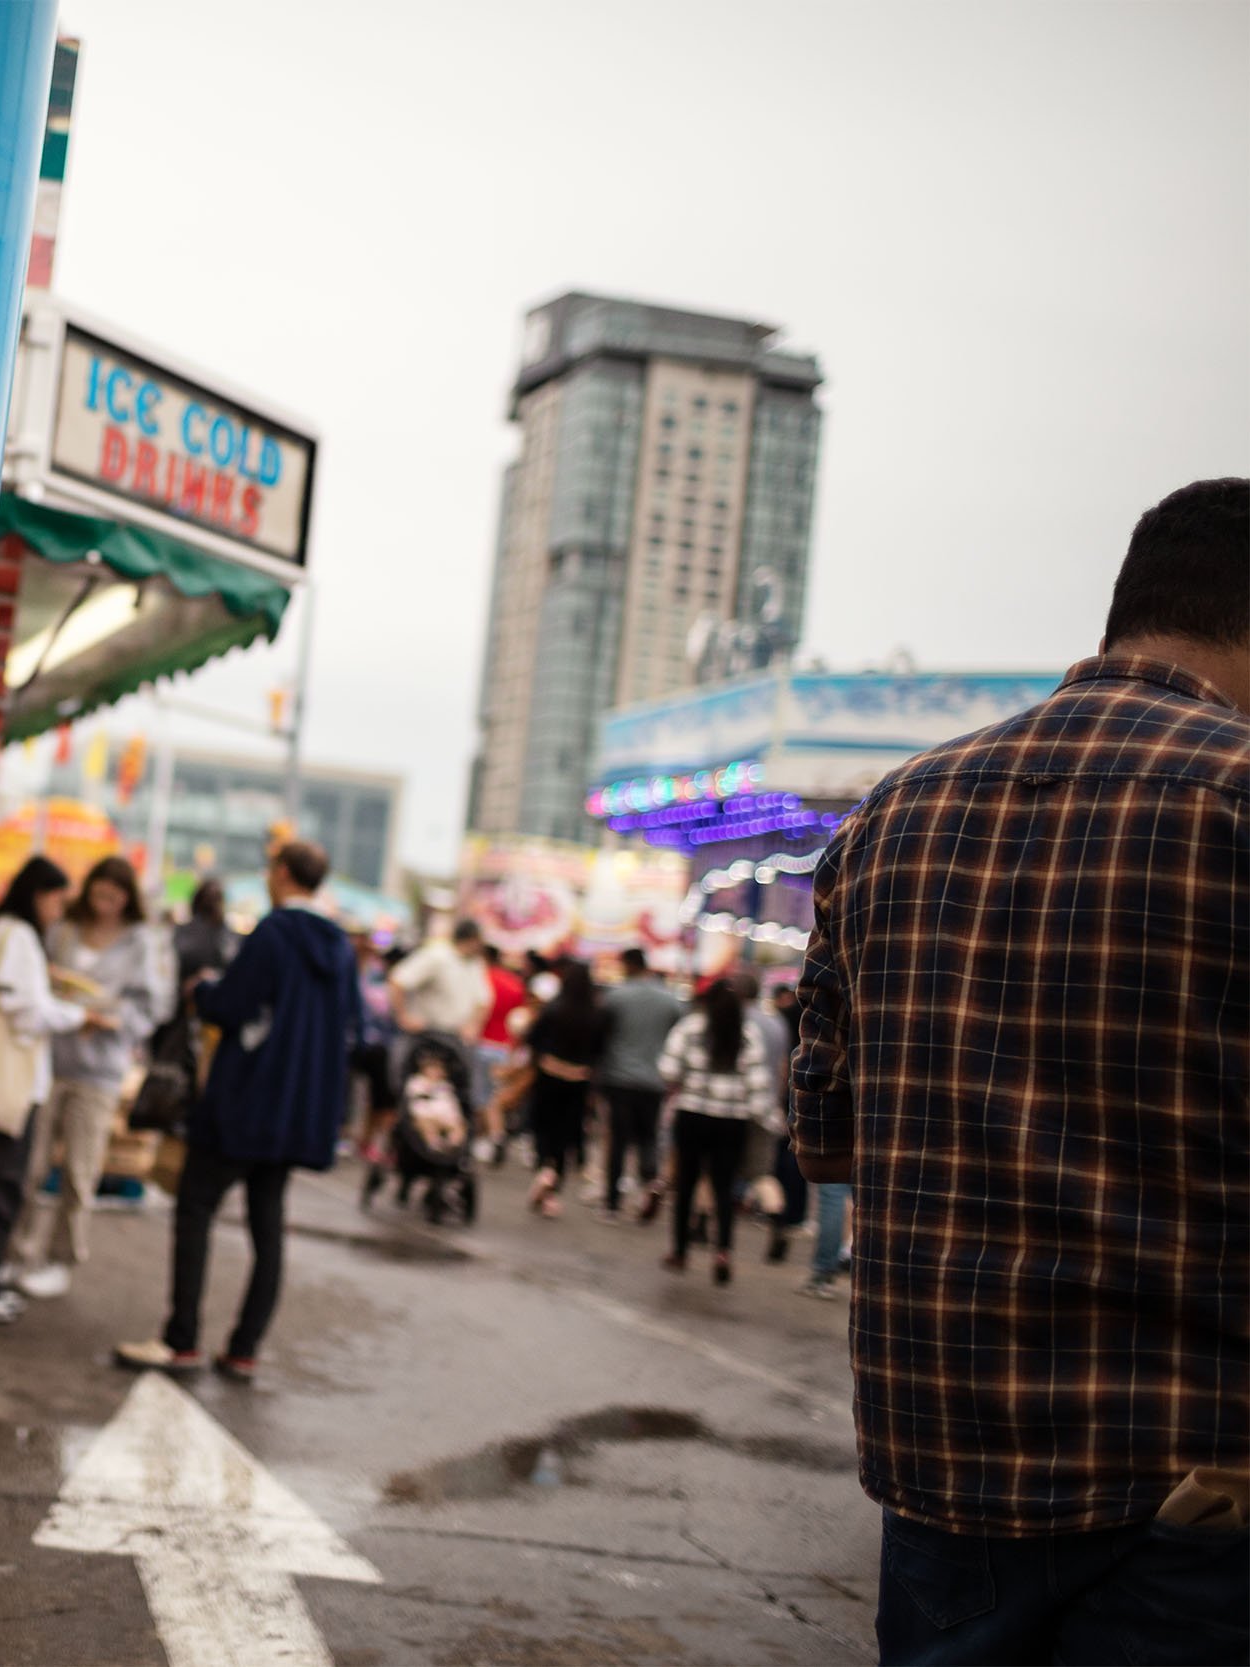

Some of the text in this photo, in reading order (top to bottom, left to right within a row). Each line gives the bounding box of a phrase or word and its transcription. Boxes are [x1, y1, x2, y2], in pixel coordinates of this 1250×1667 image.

[85, 355, 282, 487] ICE COLD
[101, 424, 263, 536] DRINKS
